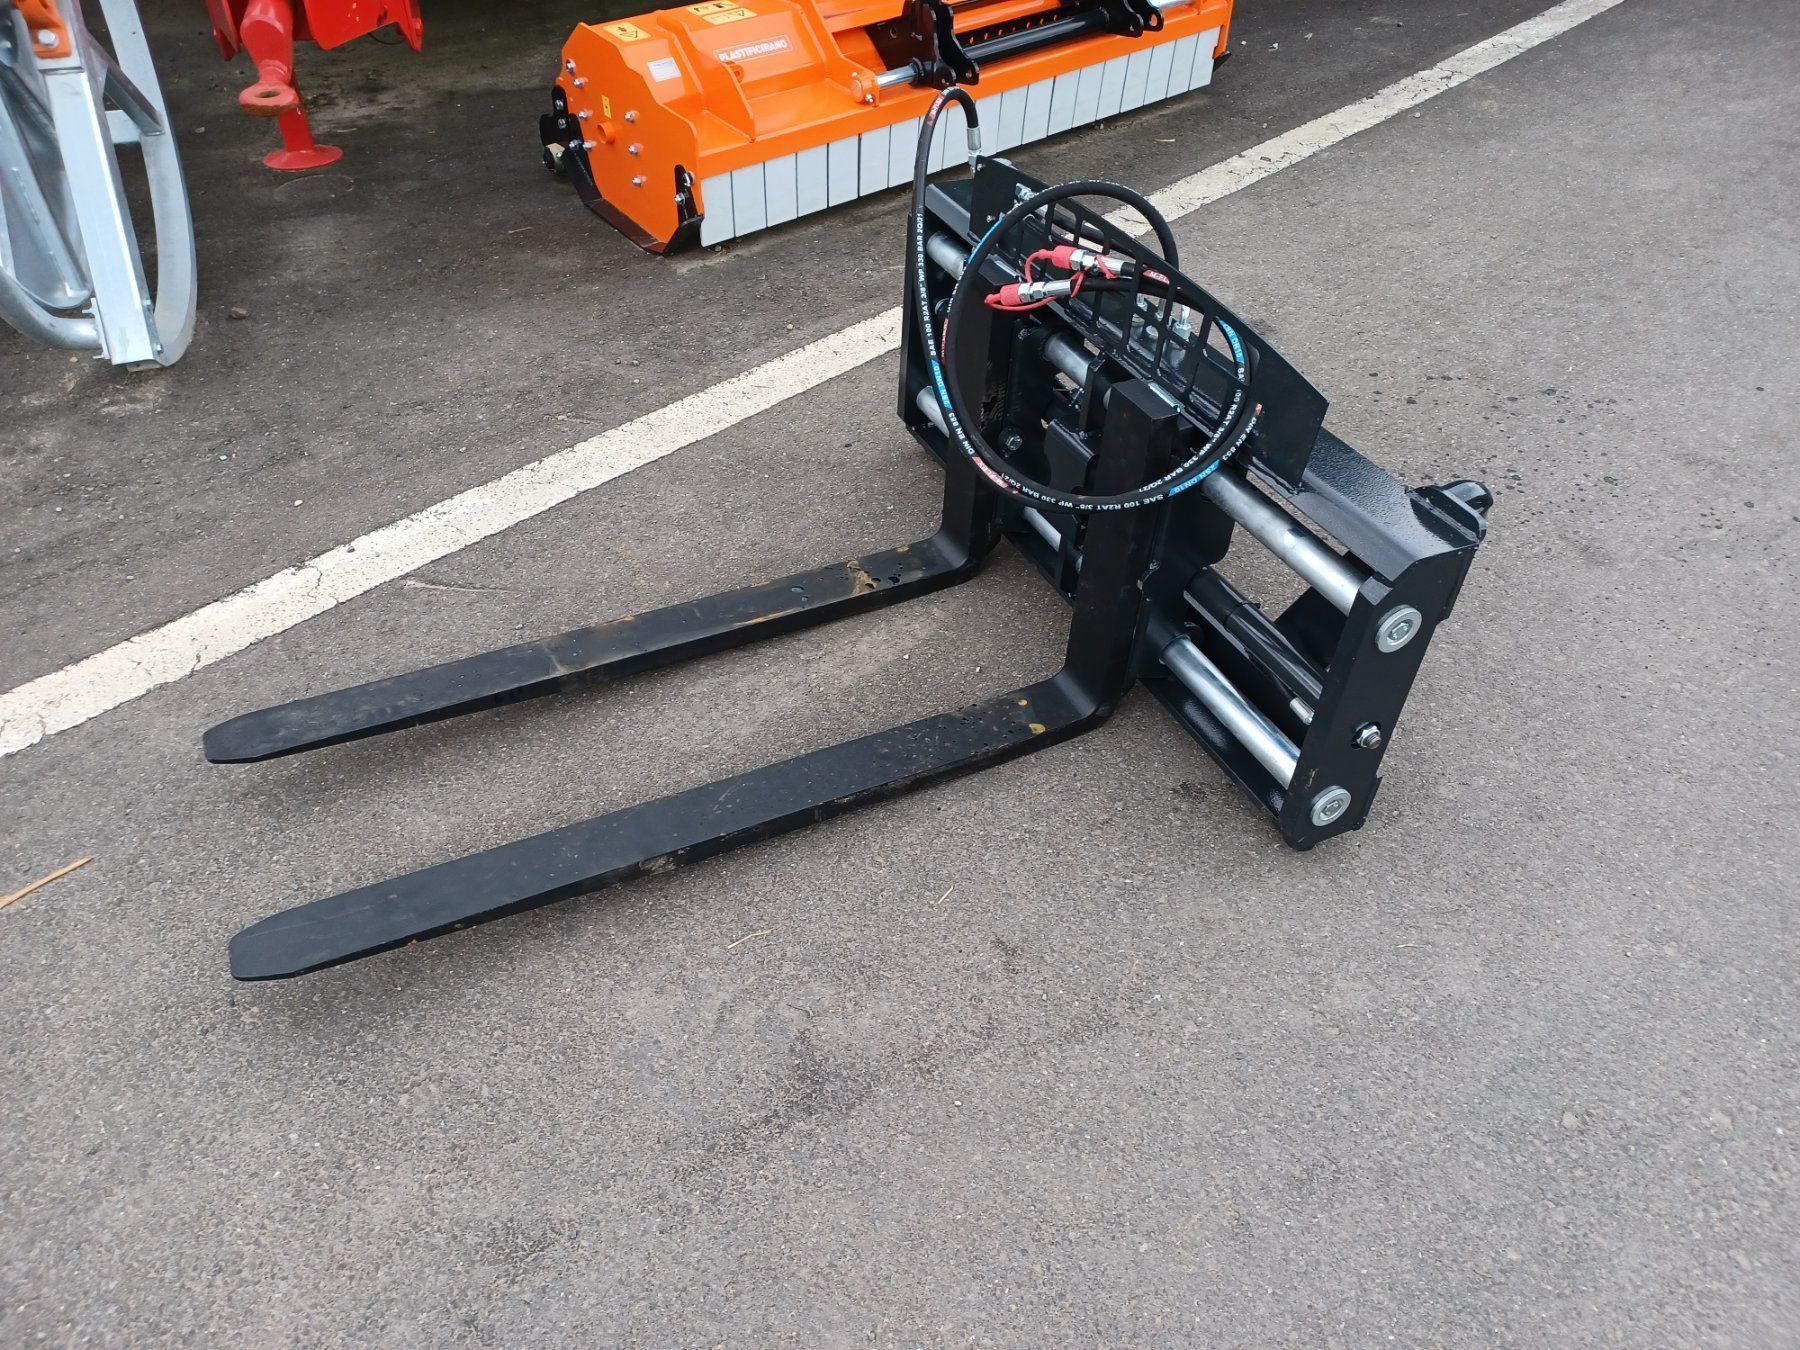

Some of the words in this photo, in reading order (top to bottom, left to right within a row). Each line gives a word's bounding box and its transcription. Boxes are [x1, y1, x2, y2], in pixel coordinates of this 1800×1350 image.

[921, 300, 931, 321] R2AT
[927, 339, 937, 356] SAE
[948, 412, 959, 427] 853
[1245, 417, 1257, 434] DIN
[955, 427, 966, 440] EN
[1235, 433, 1247, 447] EN
[963, 440, 975, 455] DIN
[1222, 446, 1237, 461] 853
[1183, 455, 1199, 468] 330
[1163, 467, 1184, 481] BAR
[1021, 485, 1040, 499] BAR
[1143, 494, 1165, 505] SAE
